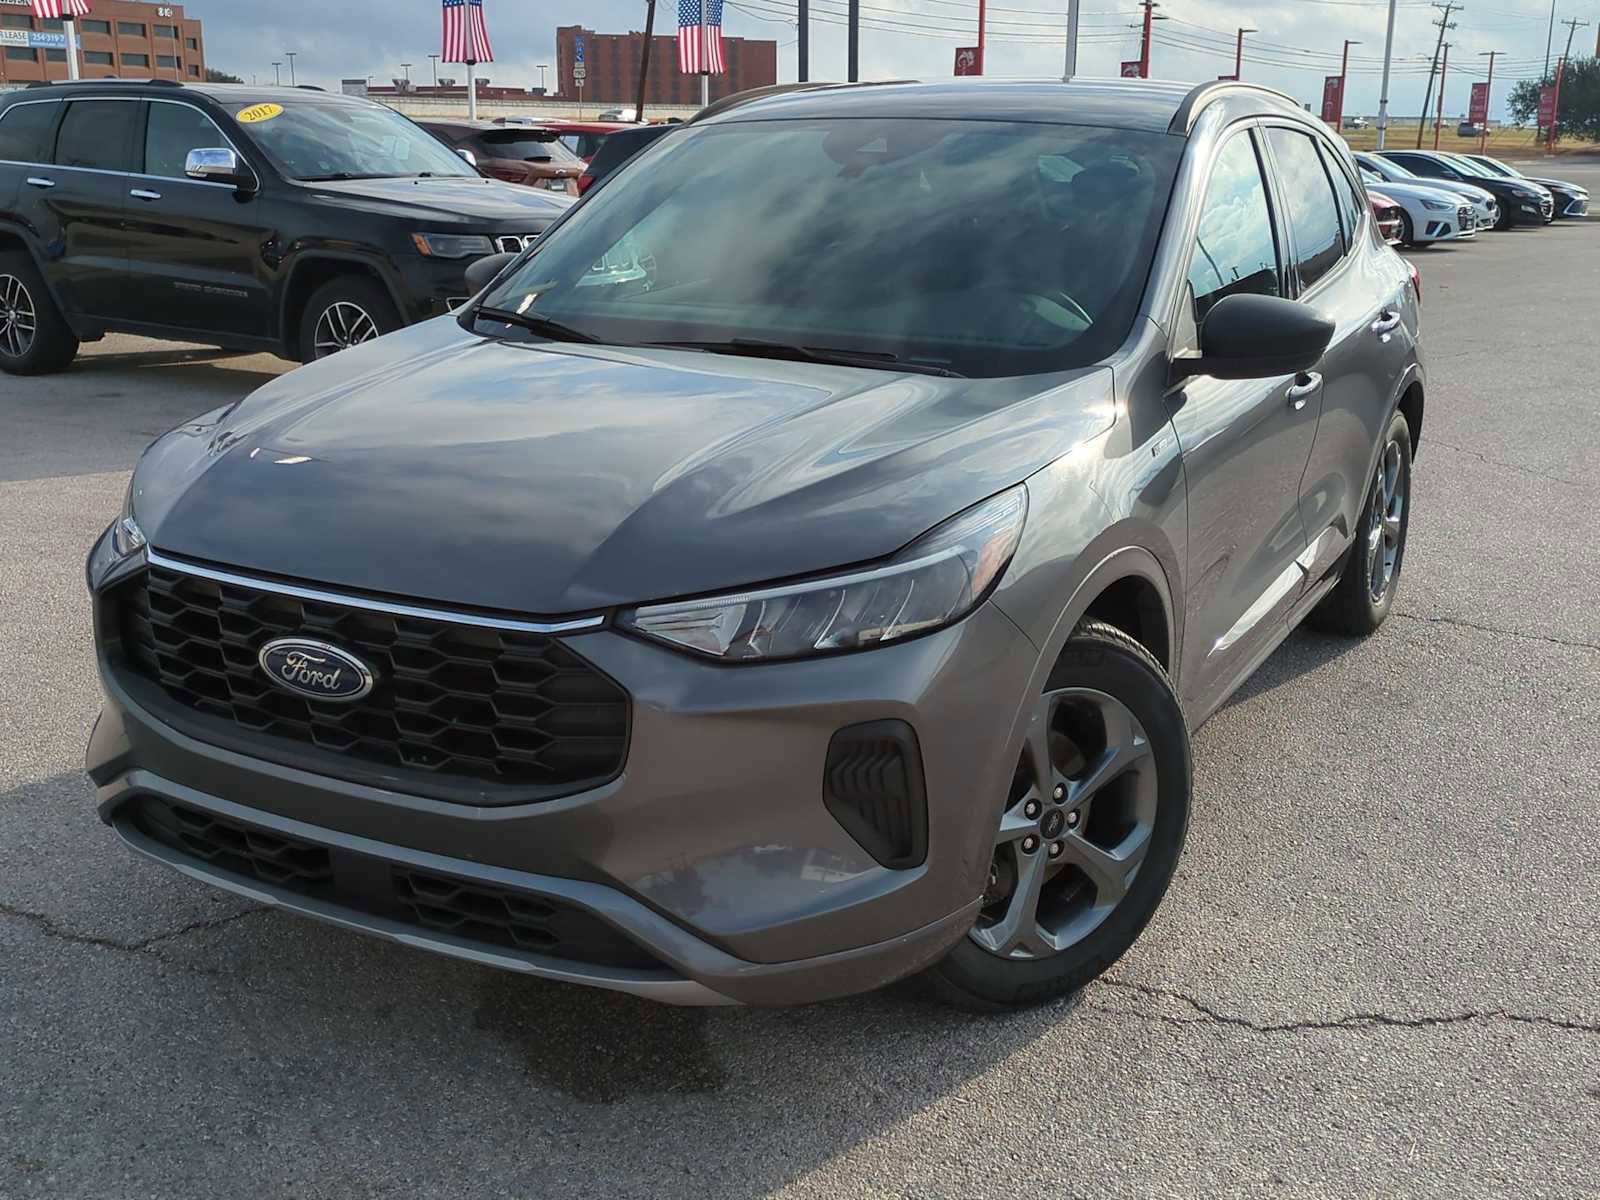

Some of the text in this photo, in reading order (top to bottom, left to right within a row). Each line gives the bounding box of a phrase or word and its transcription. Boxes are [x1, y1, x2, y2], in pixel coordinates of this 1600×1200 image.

[5, 31, 28, 40] LEASE
[244, 105, 273, 120] 2017
[281, 651, 341, 689] Ford
